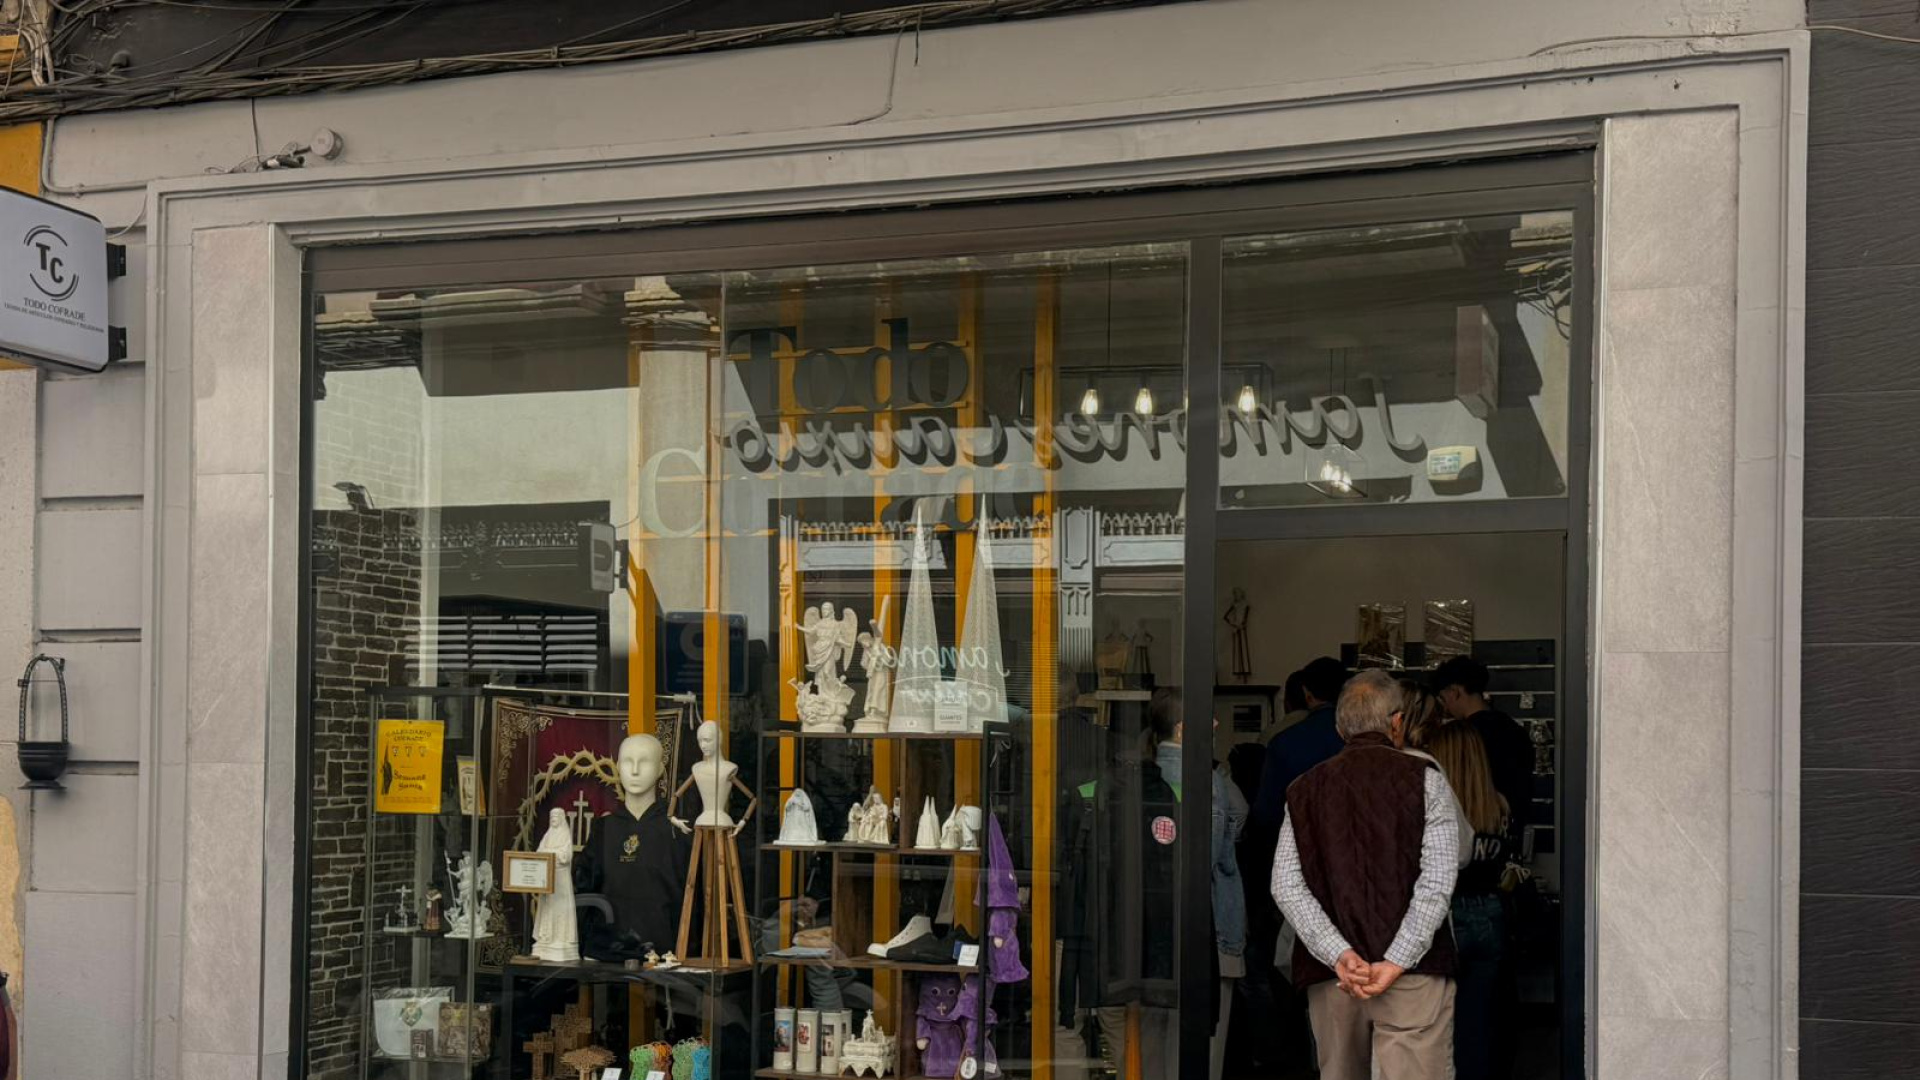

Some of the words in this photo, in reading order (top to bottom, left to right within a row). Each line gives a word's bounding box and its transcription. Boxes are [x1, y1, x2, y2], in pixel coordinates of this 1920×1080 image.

[24, 297, 47, 311] TODO
[48, 304, 86, 321] COFRADE
[727, 317, 969, 413] Todo
[639, 442, 1045, 538] Coade
